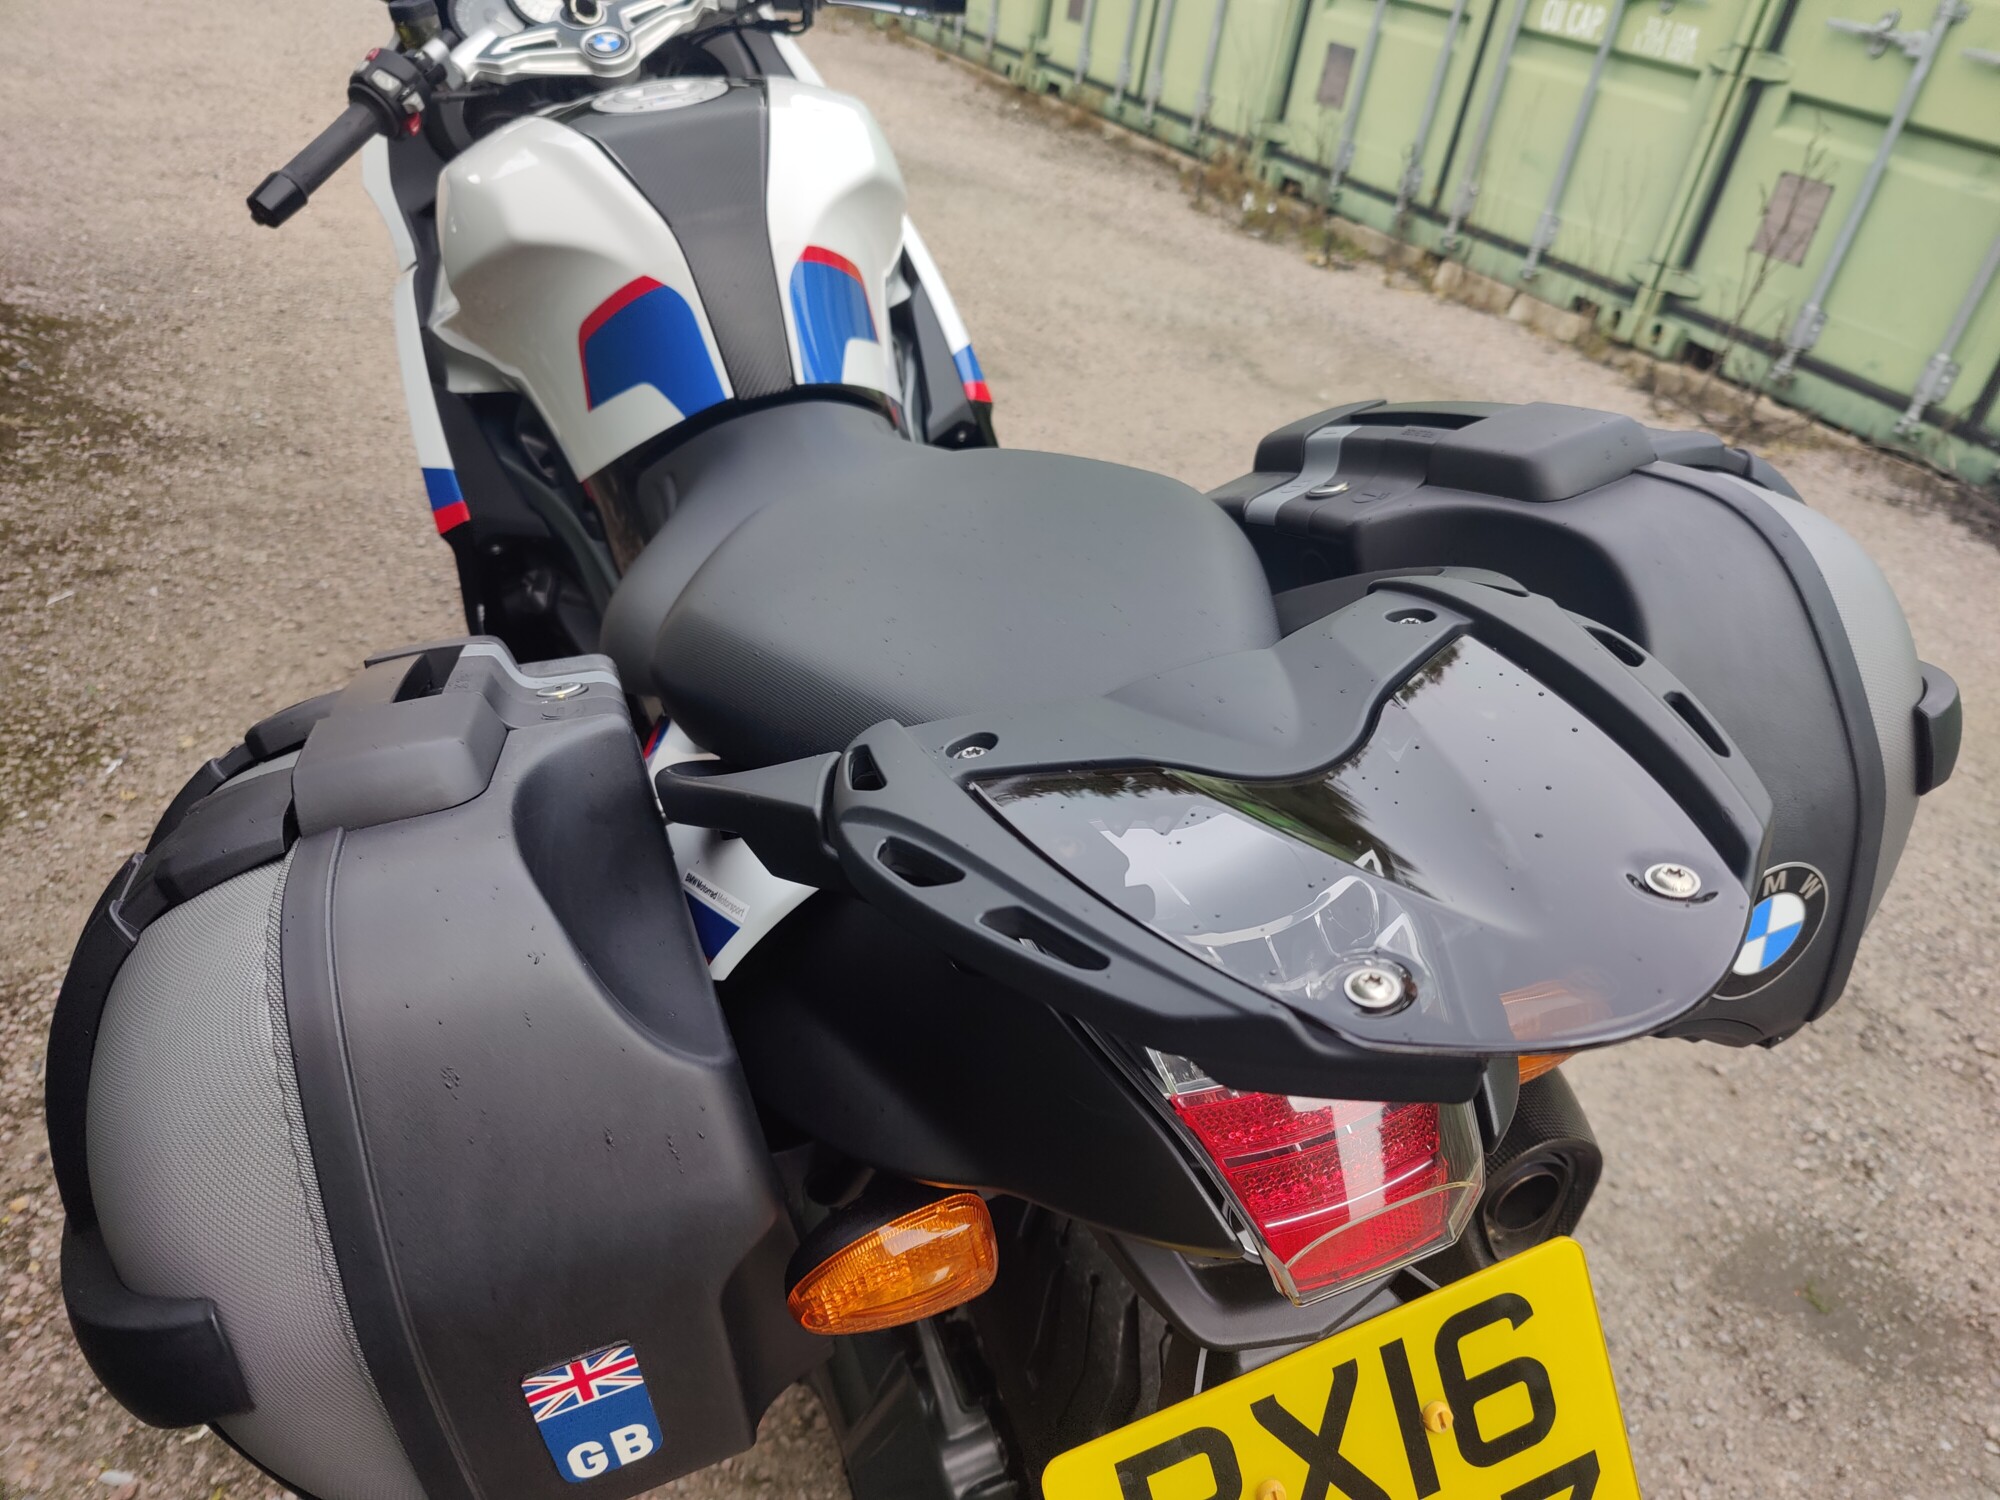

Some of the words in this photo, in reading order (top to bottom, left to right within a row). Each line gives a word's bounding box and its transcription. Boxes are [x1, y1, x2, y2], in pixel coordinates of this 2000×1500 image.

[685, 873, 698, 886] BMW
[696, 880, 719, 900] Motorrad
[716, 892, 745, 917] Motorsport
[1762, 870, 1823, 900] MW
[567, 1424, 653, 1478] GB
